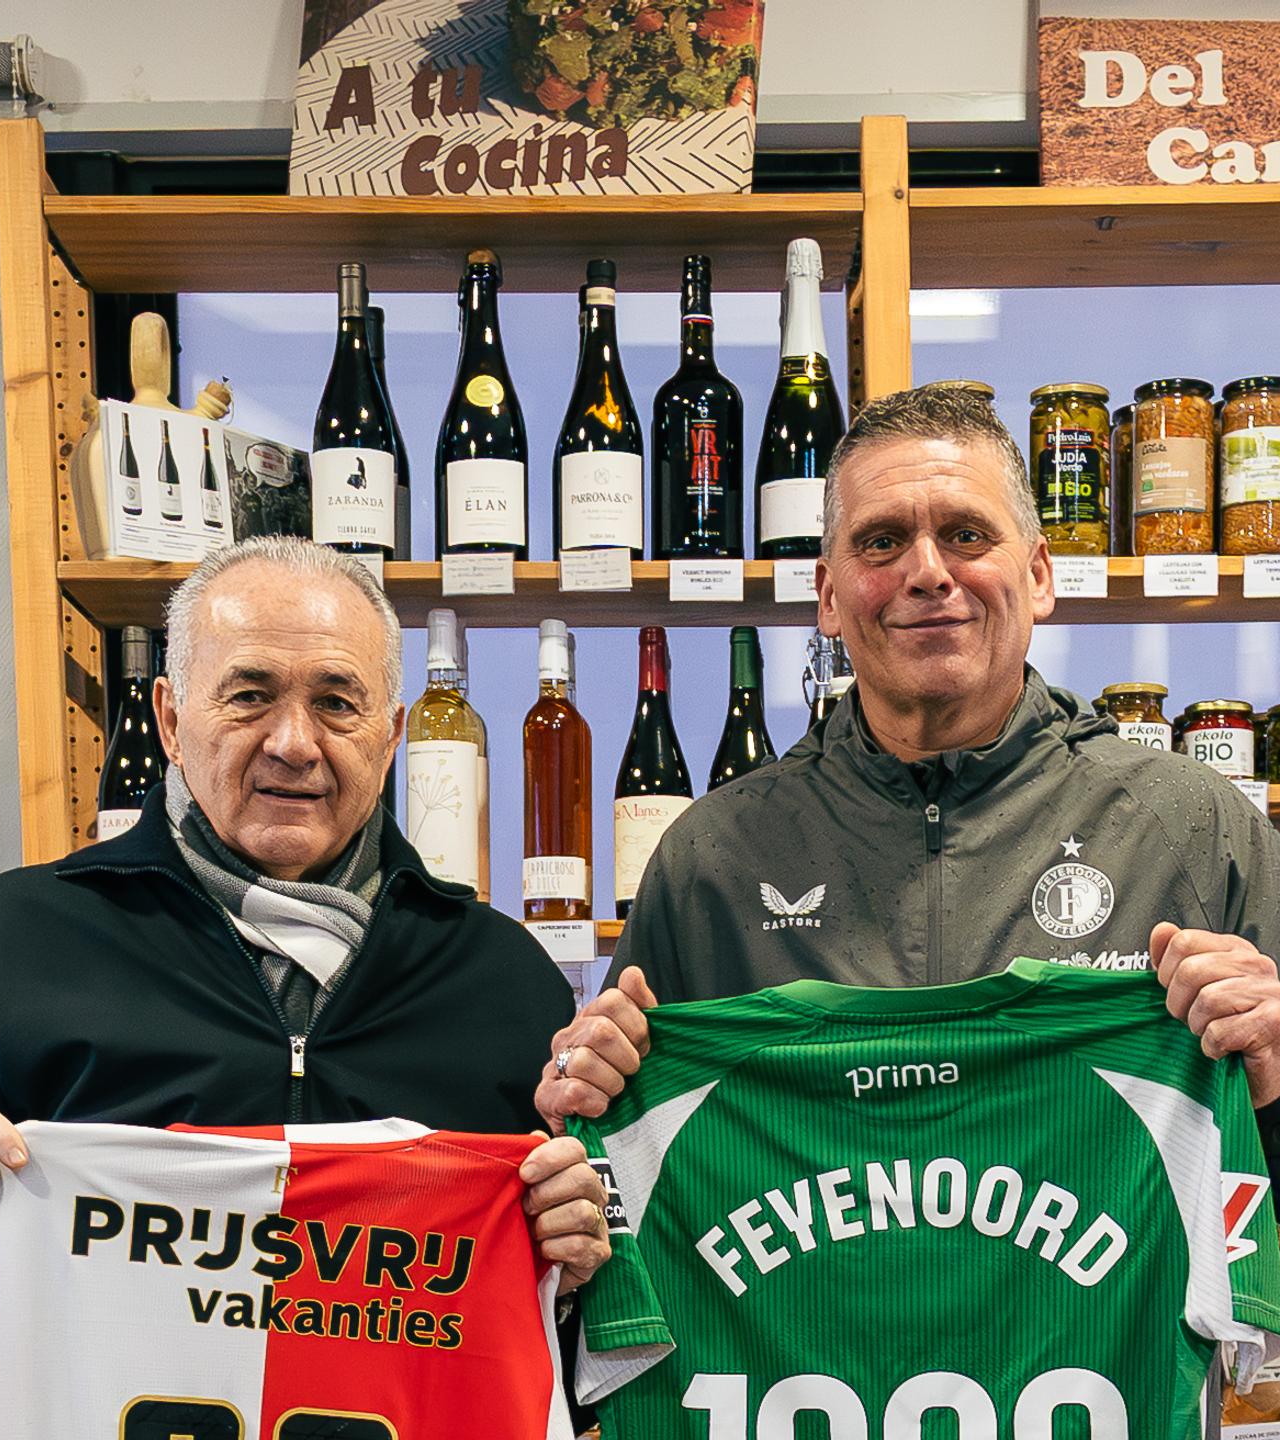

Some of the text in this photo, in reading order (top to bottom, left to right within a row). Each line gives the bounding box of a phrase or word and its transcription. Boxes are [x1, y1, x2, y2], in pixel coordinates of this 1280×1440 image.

[1078, 50, 1227, 108] Del
[325, 60, 482, 130] A tu
[401, 124, 629, 195] Cocina
[327, 495, 385, 509] ZARANDA
[464, 496, 508, 513] ÉLAN
[1127, 724, 1166, 737] ékolo
[1194, 729, 1234, 743] ékolo
[1193, 742, 1233, 761] BIO
[1038, 865, 1107, 894] FEYENOORD
[761, 917, 822, 931] CASTORE
[1039, 906, 1108, 936] ROTTERDAM
[1091, 950, 1150, 970] Markt
[845, 1057, 960, 1097] prima
[694, 1157, 1130, 1298] FEYENOORD
[187, 1283, 465, 1349] vakanties
